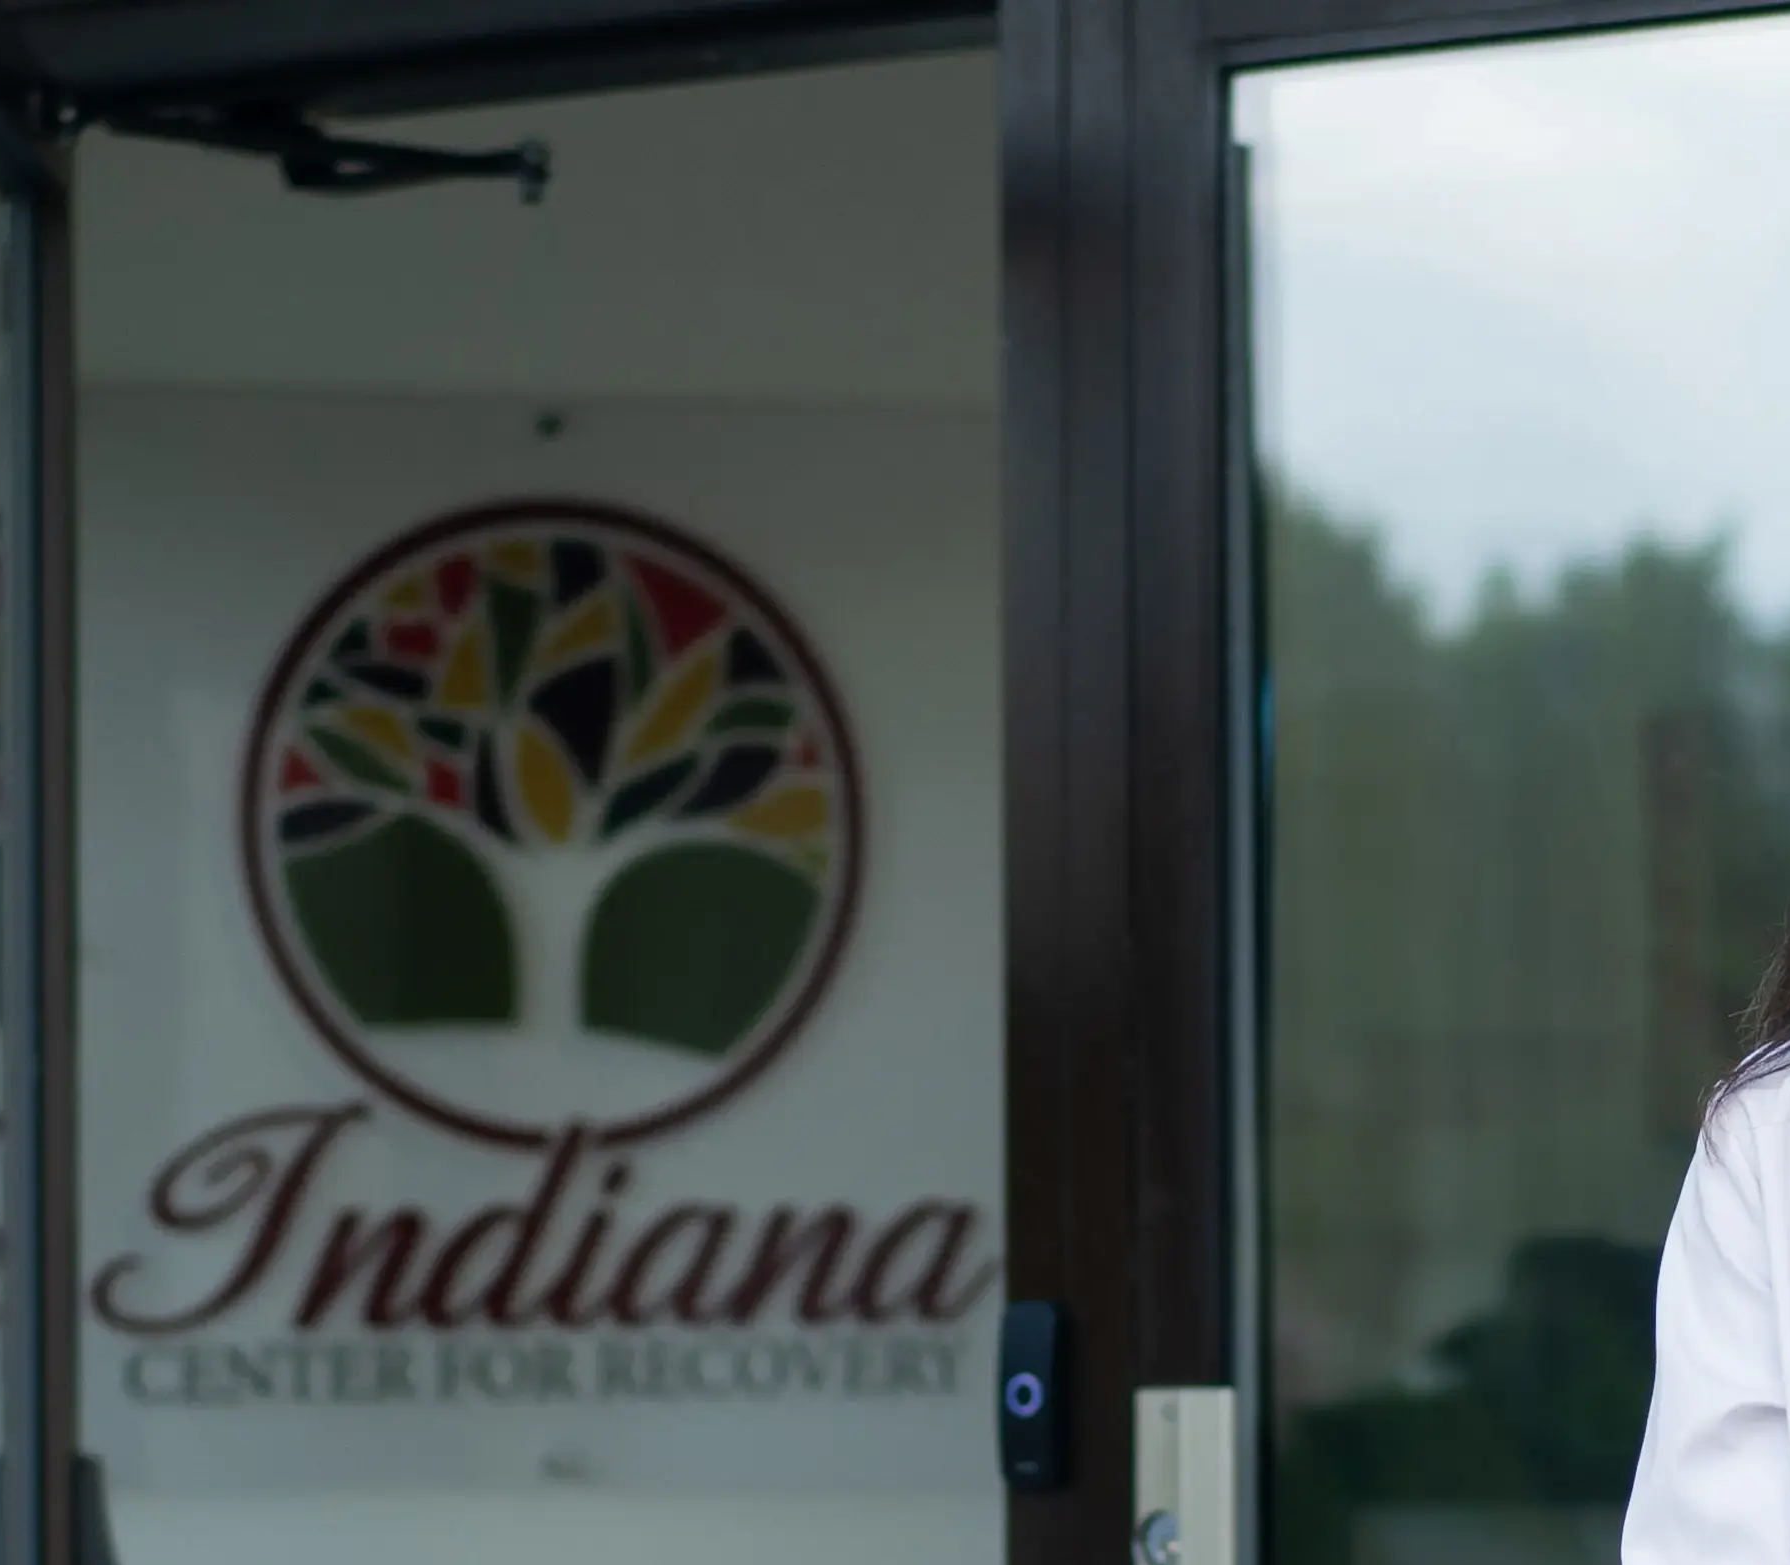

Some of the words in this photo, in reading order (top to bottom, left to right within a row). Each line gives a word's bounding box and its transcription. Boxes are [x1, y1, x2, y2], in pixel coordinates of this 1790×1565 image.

[90, 1099, 1001, 1335] Indiana
[122, 1336, 417, 1404] CENTER
[435, 1335, 582, 1402] FOR
[595, 1332, 963, 1399] RECOVERY
